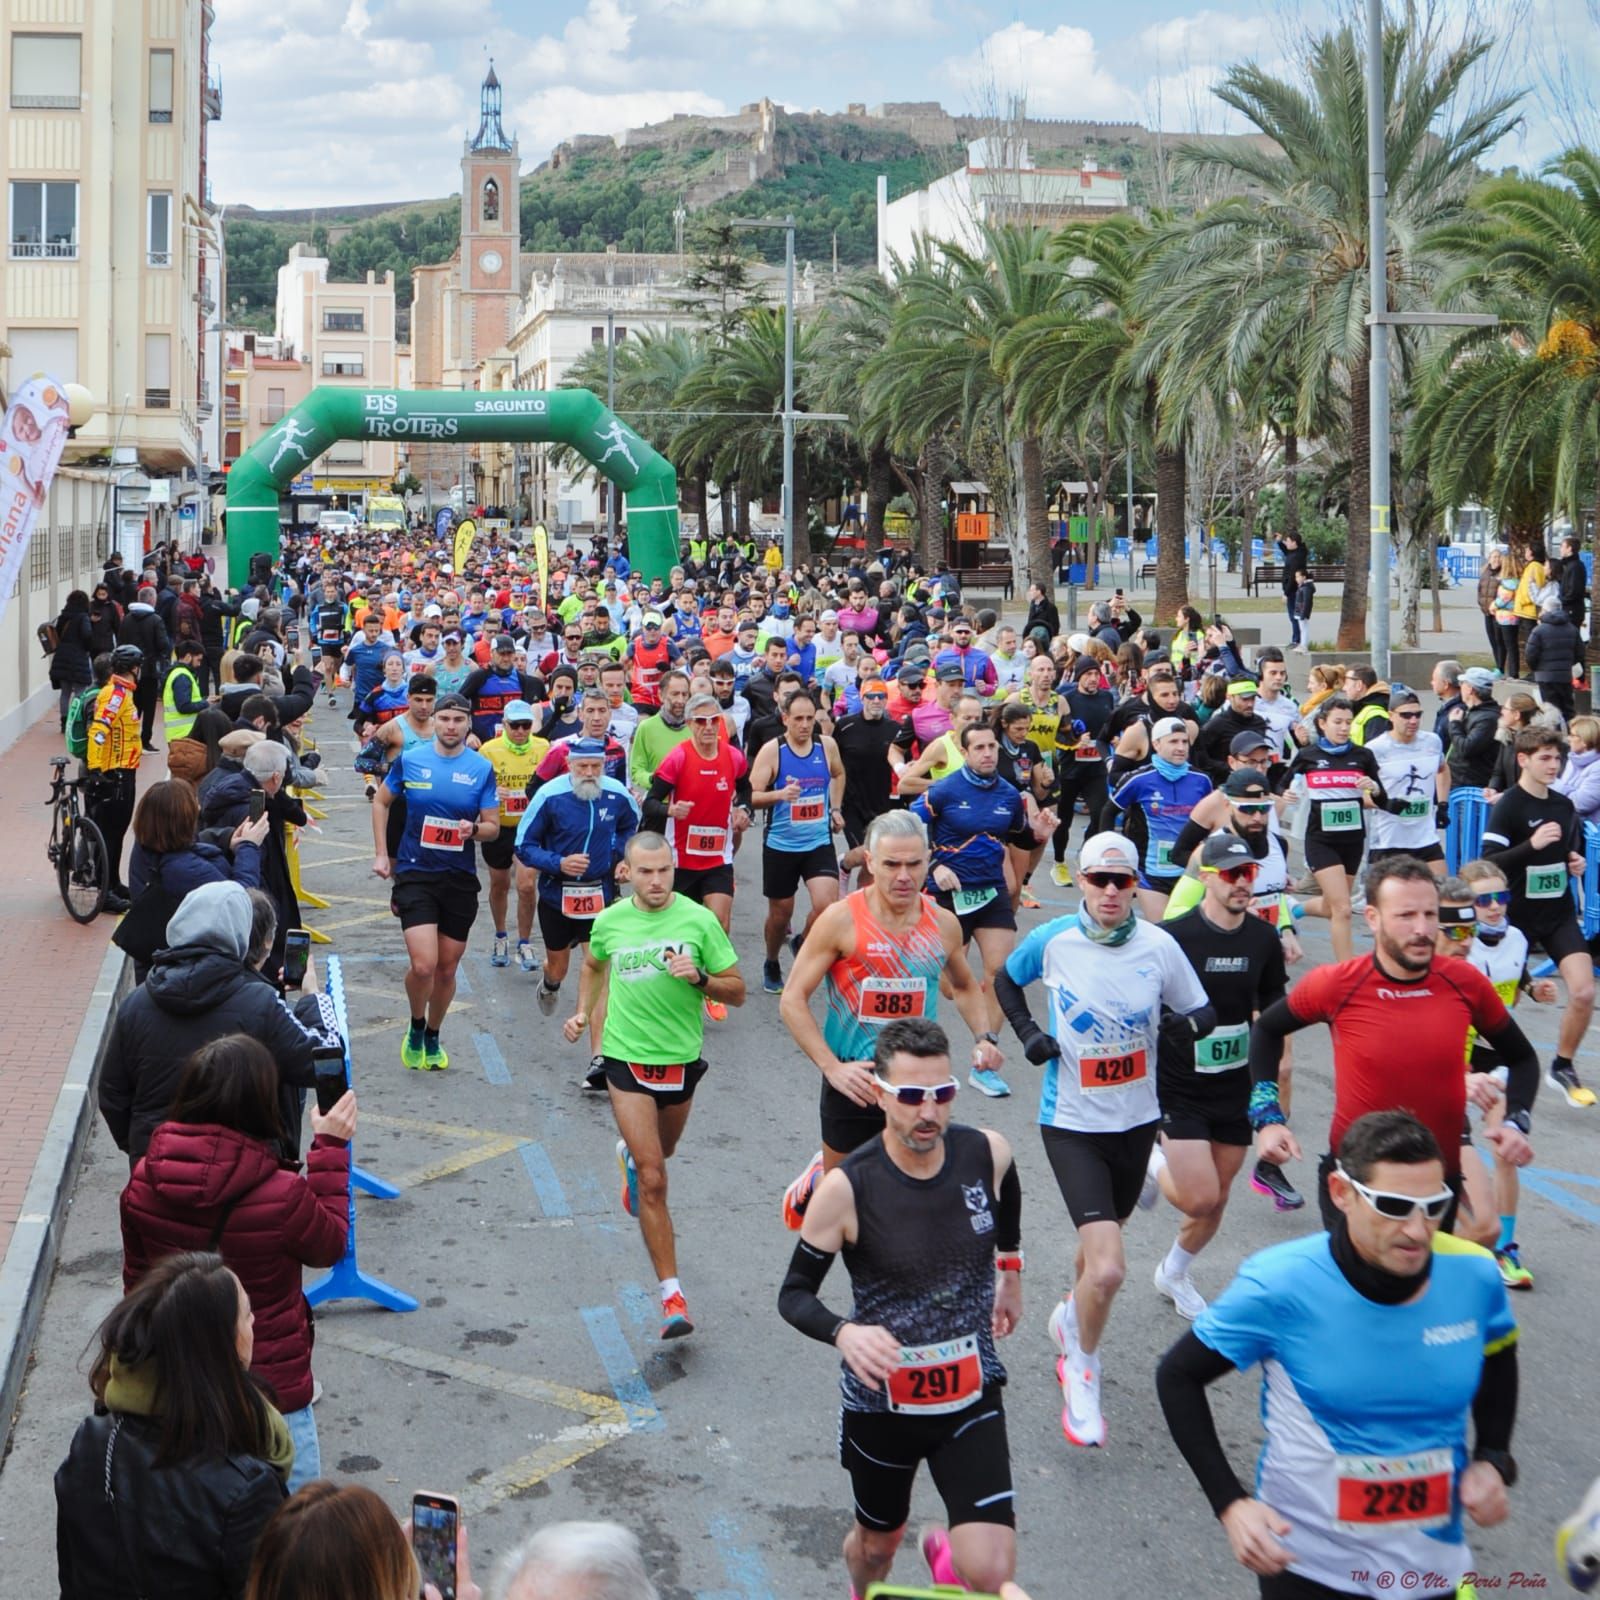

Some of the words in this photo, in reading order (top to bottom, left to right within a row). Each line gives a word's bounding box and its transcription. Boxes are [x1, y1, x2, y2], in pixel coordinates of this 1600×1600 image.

[365, 394, 398, 415] ELS
[474, 400, 546, 413] SAGUNTO
[365, 416, 458, 438] TROTERS
[800, 805, 818, 817] 413
[1330, 811, 1353, 823] 709
[435, 828, 453, 843] 20
[700, 836, 715, 849] 69
[1537, 874, 1560, 890] 738
[574, 898, 594, 912] 213
[874, 993, 913, 1014] 383
[1211, 1040, 1240, 1061] 674
[1095, 1056, 1134, 1082] 420
[908, 1365, 960, 1399] 297
[1363, 1480, 1428, 1517] 228
